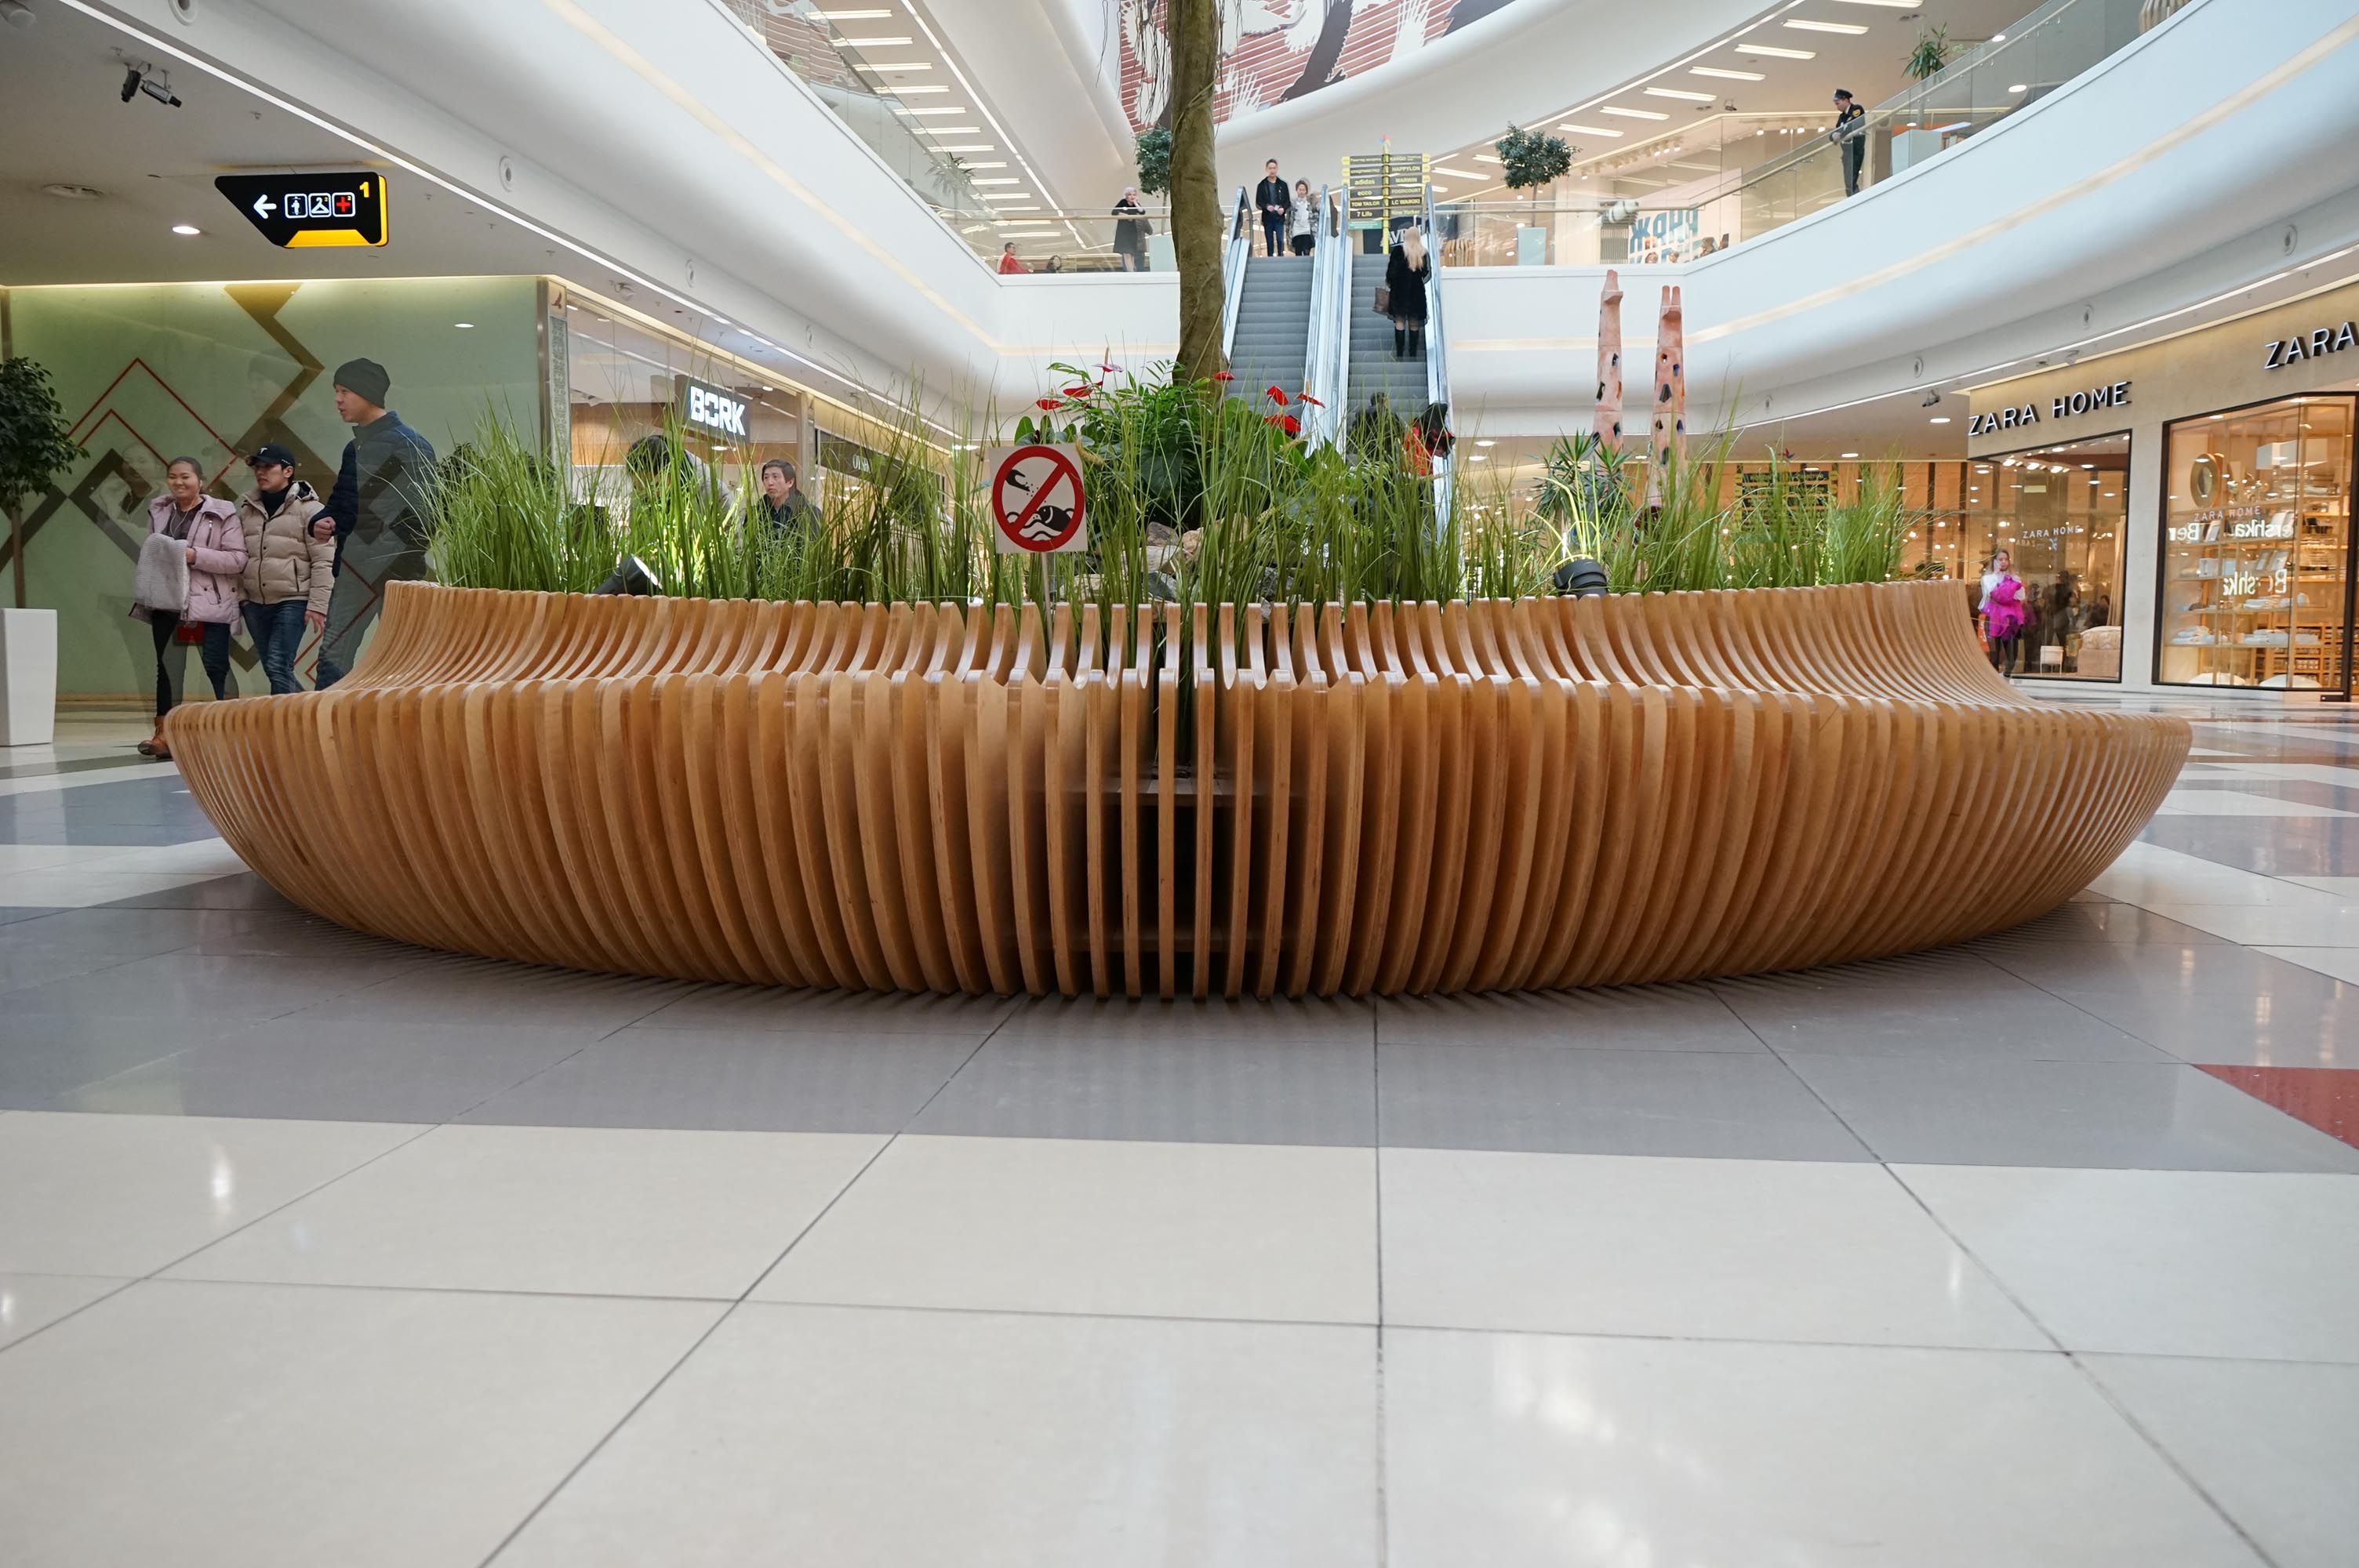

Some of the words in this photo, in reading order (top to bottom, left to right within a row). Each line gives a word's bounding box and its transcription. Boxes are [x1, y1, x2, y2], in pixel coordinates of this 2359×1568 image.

[359, 181, 369, 198] 1
[2264, 321, 2358, 369] ZARA
[690, 386, 746, 436] BORK
[1968, 403, 2039, 436] ZARA
[2052, 381, 2132, 419] HOME
[2194, 510, 2223, 522] ZARA
[2229, 505, 2261, 518] HOME
[2023, 529, 2050, 539] ZARA
[2053, 524, 2081, 536] HOME
